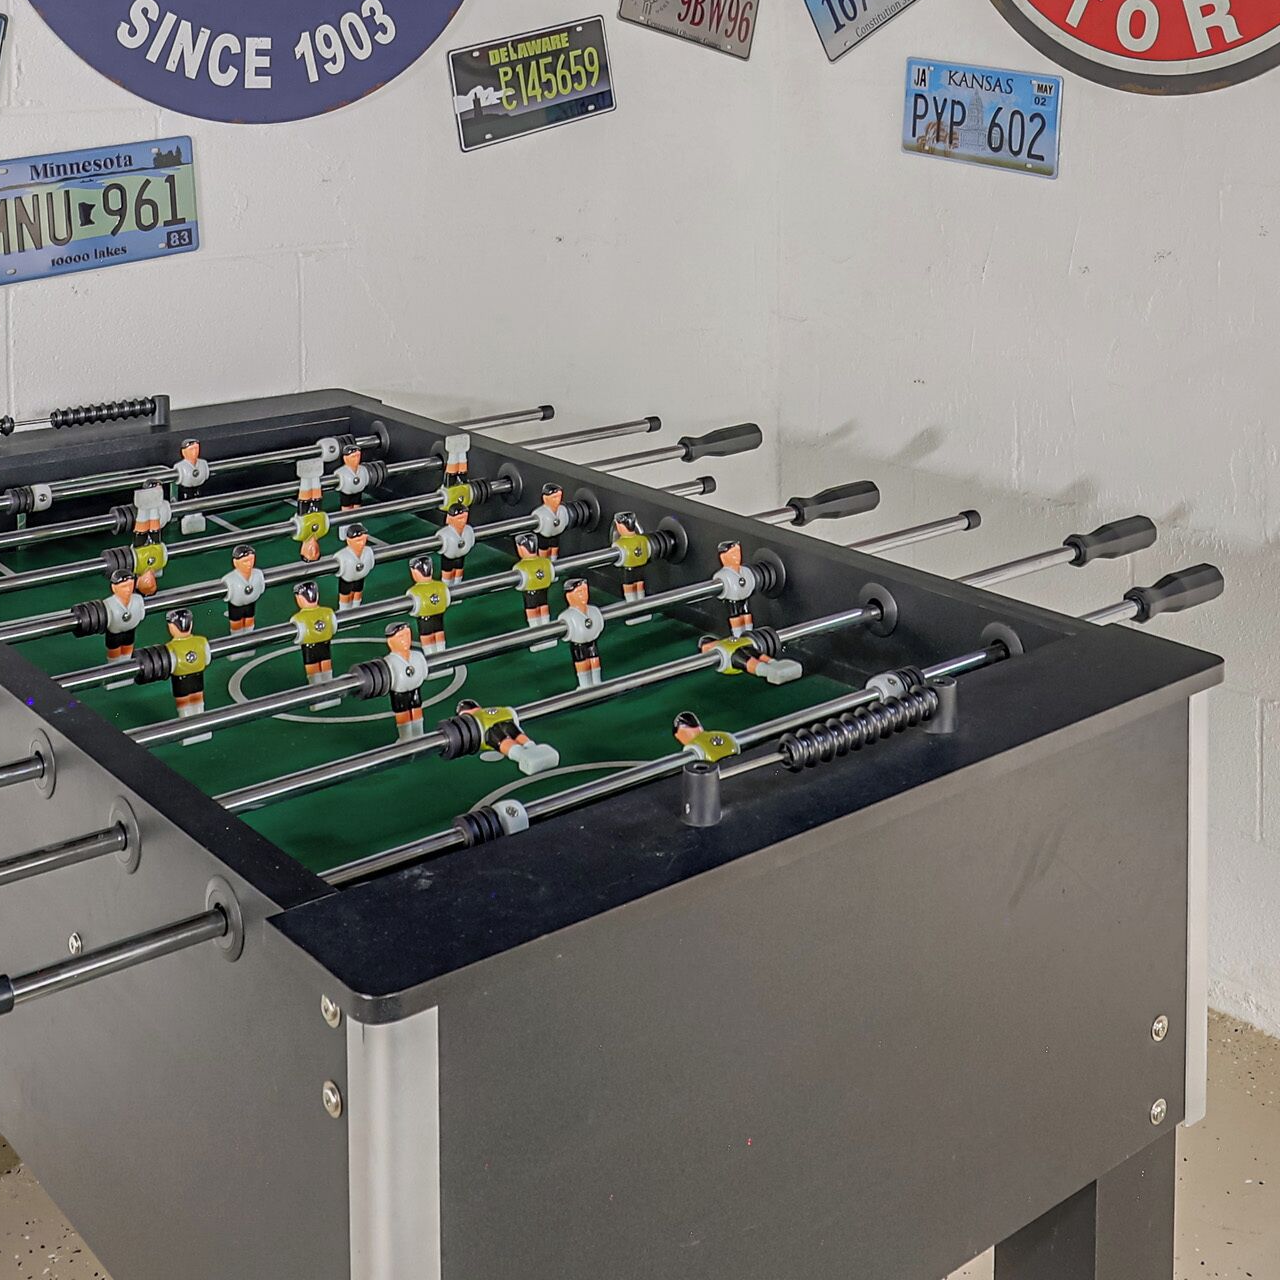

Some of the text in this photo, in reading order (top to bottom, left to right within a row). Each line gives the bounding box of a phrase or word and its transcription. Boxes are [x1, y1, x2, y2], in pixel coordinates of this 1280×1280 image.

[488, 31, 570, 66] DELAWARE
[516, 46, 600, 107] 145659
[947, 69, 1015, 96] KANSAS
[1036, 83, 1054, 95] MAY
[911, 93, 1047, 162] PYP 602
[28, 151, 135, 183] Minnesota
[168, 230, 192, 249] 83
[50, 244, 129, 269] 10000 lakes
